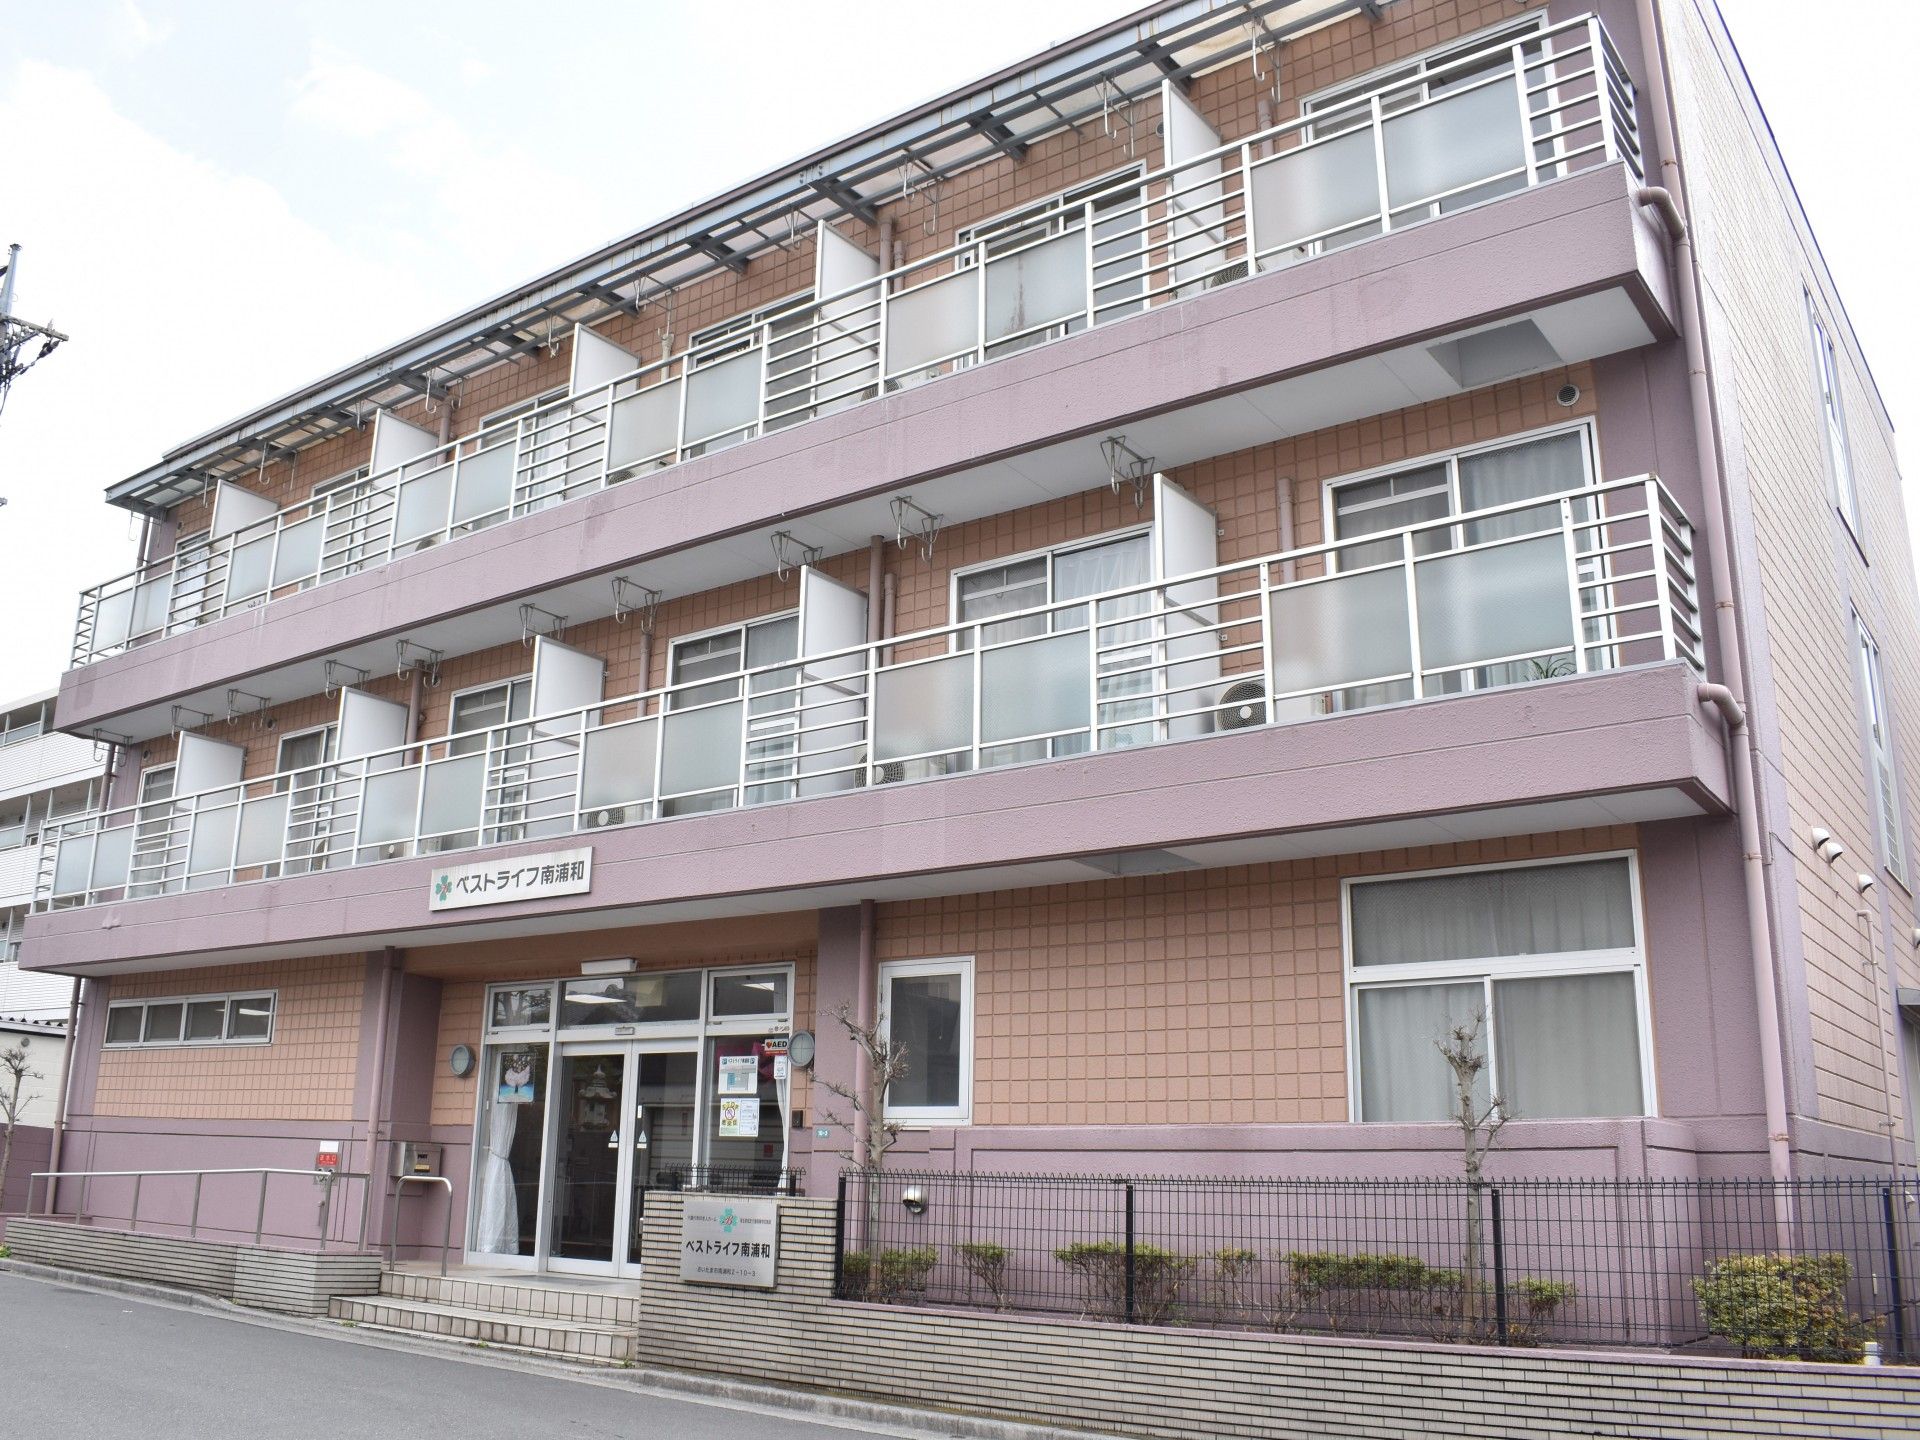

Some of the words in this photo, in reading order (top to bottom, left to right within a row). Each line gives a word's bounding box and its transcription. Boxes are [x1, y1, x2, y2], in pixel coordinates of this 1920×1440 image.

[456, 860, 585, 894] ベストライフ南浦和
[772, 1040, 788, 1048] AED
[686, 1240, 771, 1258] ベストライフ南浦和
